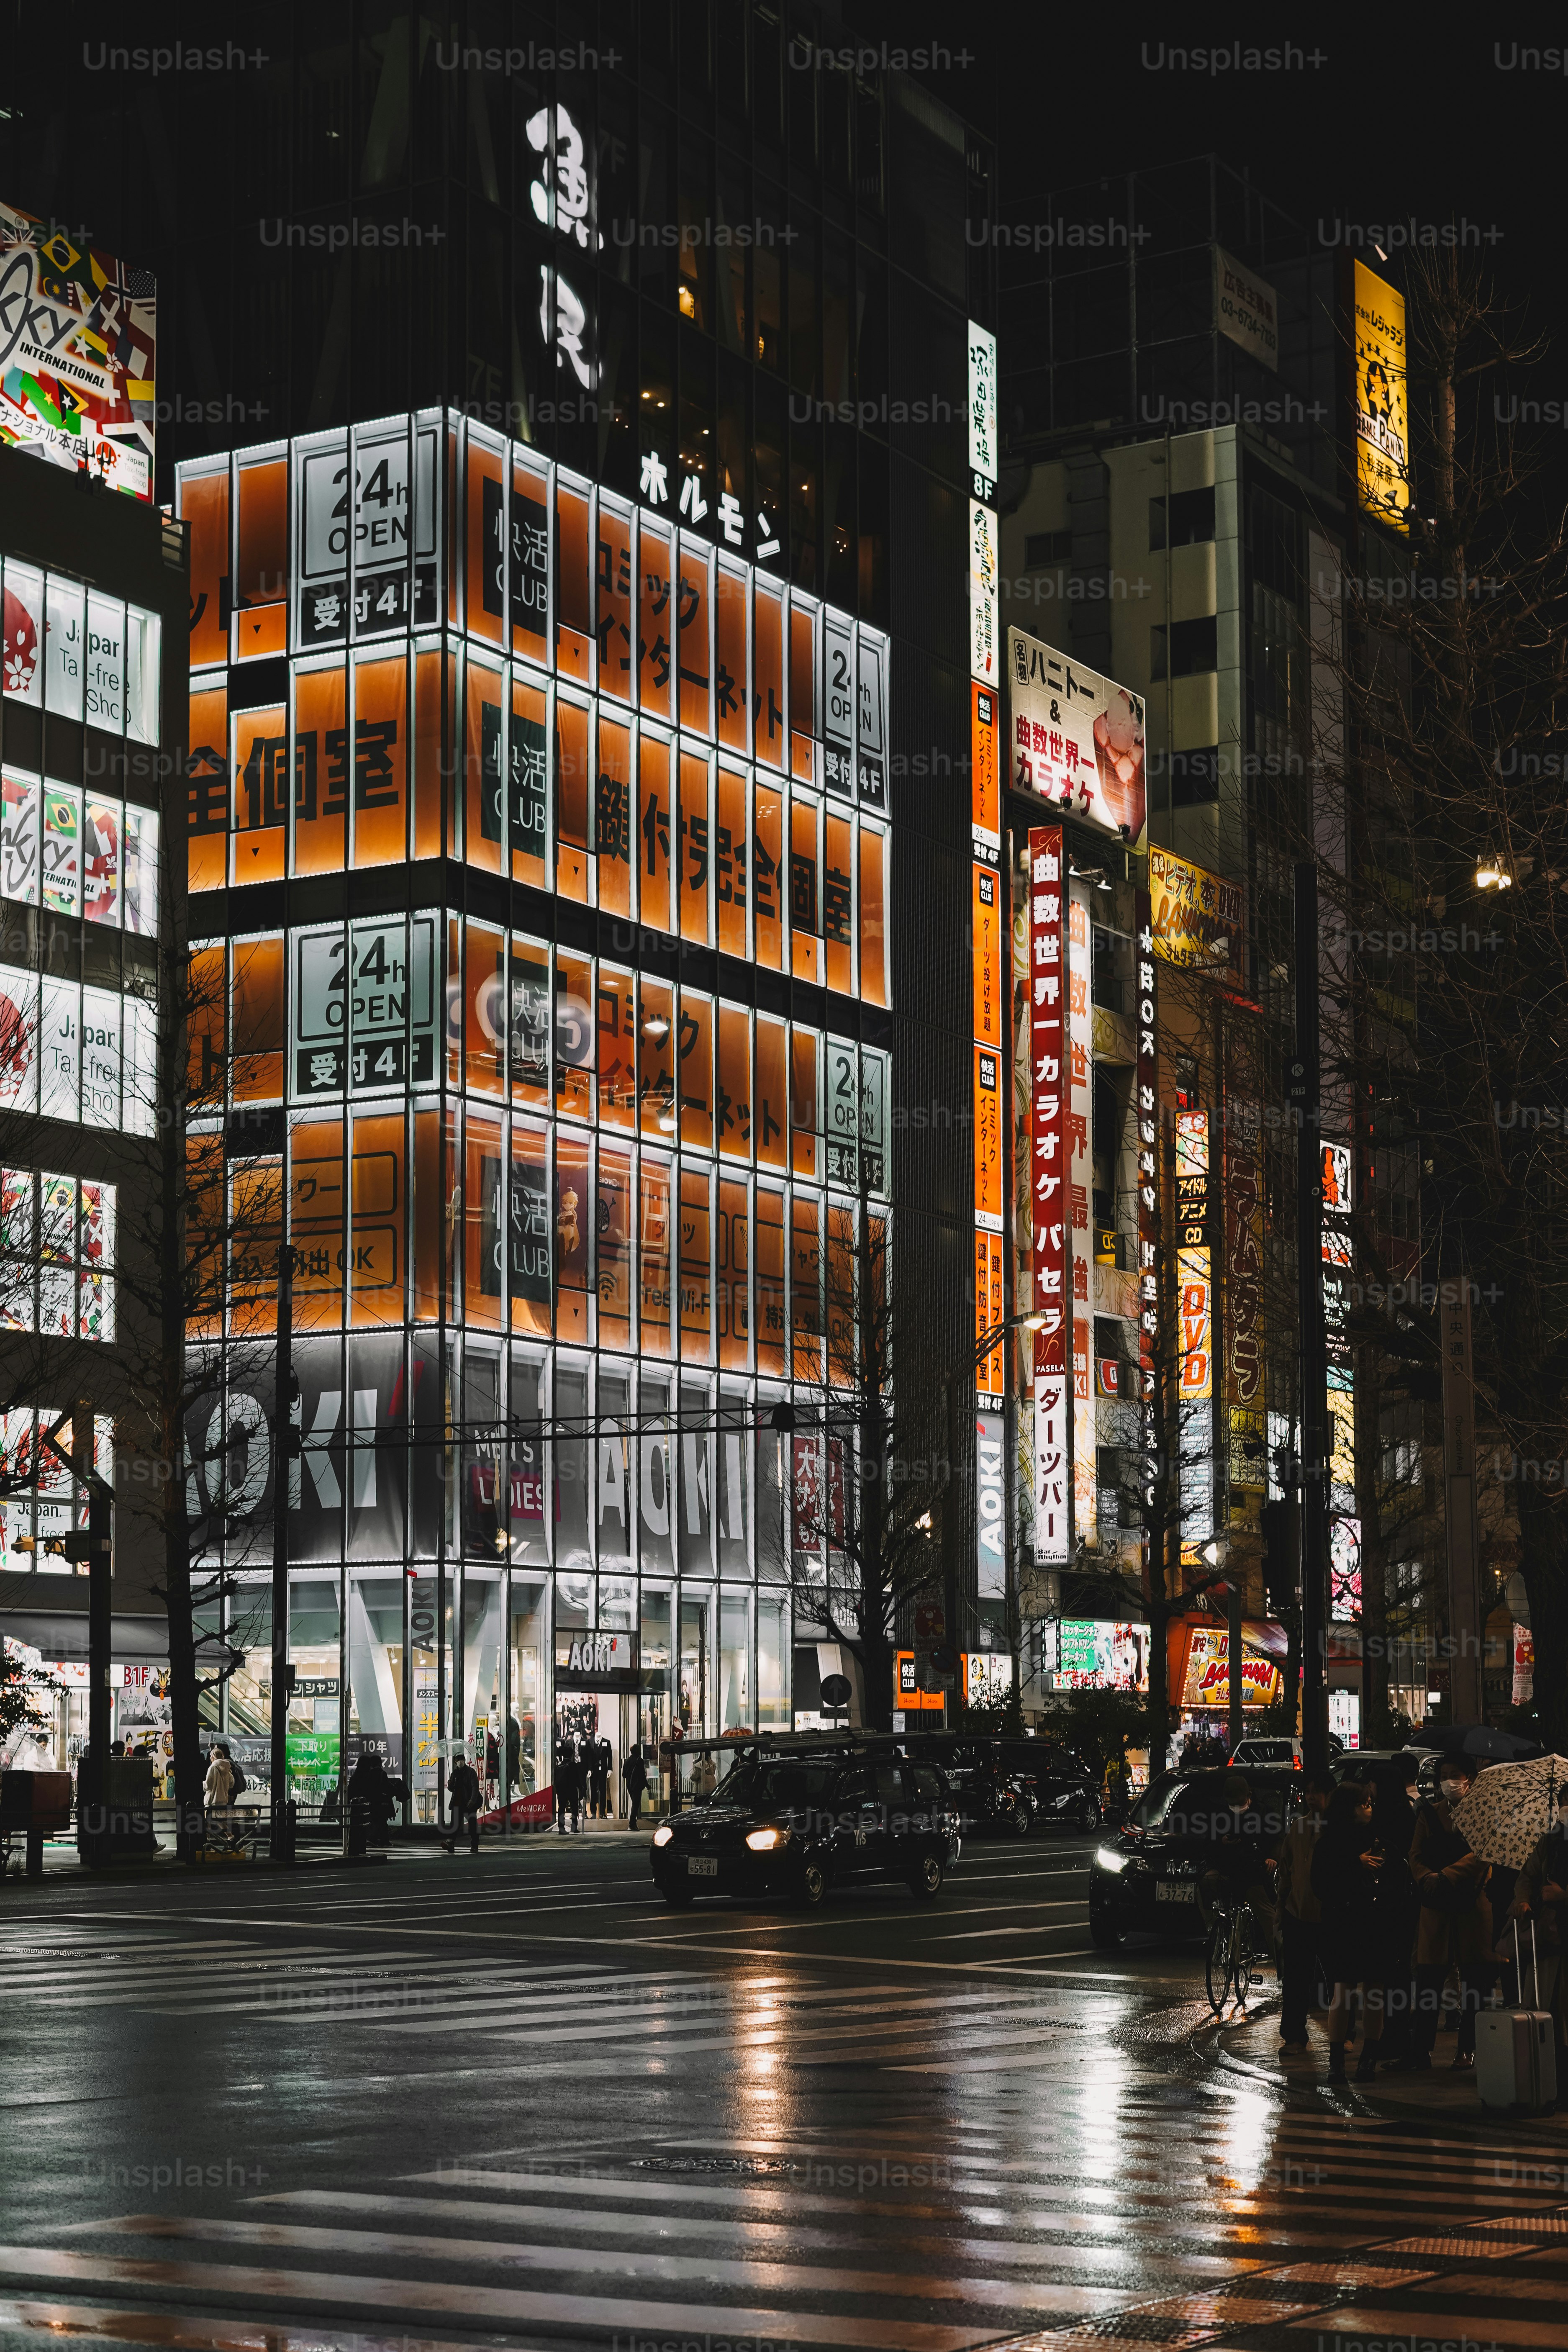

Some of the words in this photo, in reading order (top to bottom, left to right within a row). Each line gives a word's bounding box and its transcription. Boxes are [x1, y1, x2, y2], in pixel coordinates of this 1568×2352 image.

[20, 341, 105, 390] INTERNATIONAL
[126, 454, 147, 469] Japan.
[331, 459, 408, 519] 24h
[973, 473, 993, 501] 8F
[640, 451, 780, 559] ホルモン
[328, 514, 408, 555] OPEN
[1016, 643, 1027, 682] 名物
[1030, 647, 1094, 701] ハニトー
[979, 696, 990, 712] 快活
[1050, 699, 1062, 725] &
[979, 709, 991, 722] CLUB
[1016, 714, 1094, 773] 曲数世界一
[1016, 752, 1094, 817] カラオケ
[980, 878, 992, 893] 快活
[981, 890, 992, 902] CLUB
[328, 936, 406, 991] 24h
[325, 992, 406, 1027] OPEN
[980, 1059, 994, 1076] 快活
[981, 1074, 994, 1086] CLUB
[1140, 1084, 1155, 1212] カラオケ
[1178, 1177, 1208, 1197] アイドル
[1180, 1202, 1207, 1220] アニメ
[988, 1218, 1000, 1227] OPEN
[1185, 1227, 1202, 1244] CD
[991, 1255, 1001, 1374] 鍵付ブス
[1182, 1281, 1210, 1392] DVD
[1036, 1364, 1065, 1373] PASELA
[184, 1389, 377, 1516] OKI
[1039, 1388, 1062, 1537] ダーツバー
[980, 1440, 1002, 1556] AOKI
[411, 1580, 435, 1654] AOKI
[569, 1642, 611, 1672] AOKI
[124, 1666, 150, 1687] B1F
[902, 1664, 915, 1677] 快活
[902, 1678, 915, 1688] CLUB
[298, 1740, 327, 1753] 下取り
[362, 1740, 388, 1754] 10年
[287, 1756, 338, 1768] キャンペーン
[287, 1778, 337, 1792] お得にお買い物
[516, 1804, 547, 1813] MeWORK
[695, 1864, 715, 1874] 55-81
[1165, 1890, 1193, 1901] 37-76
